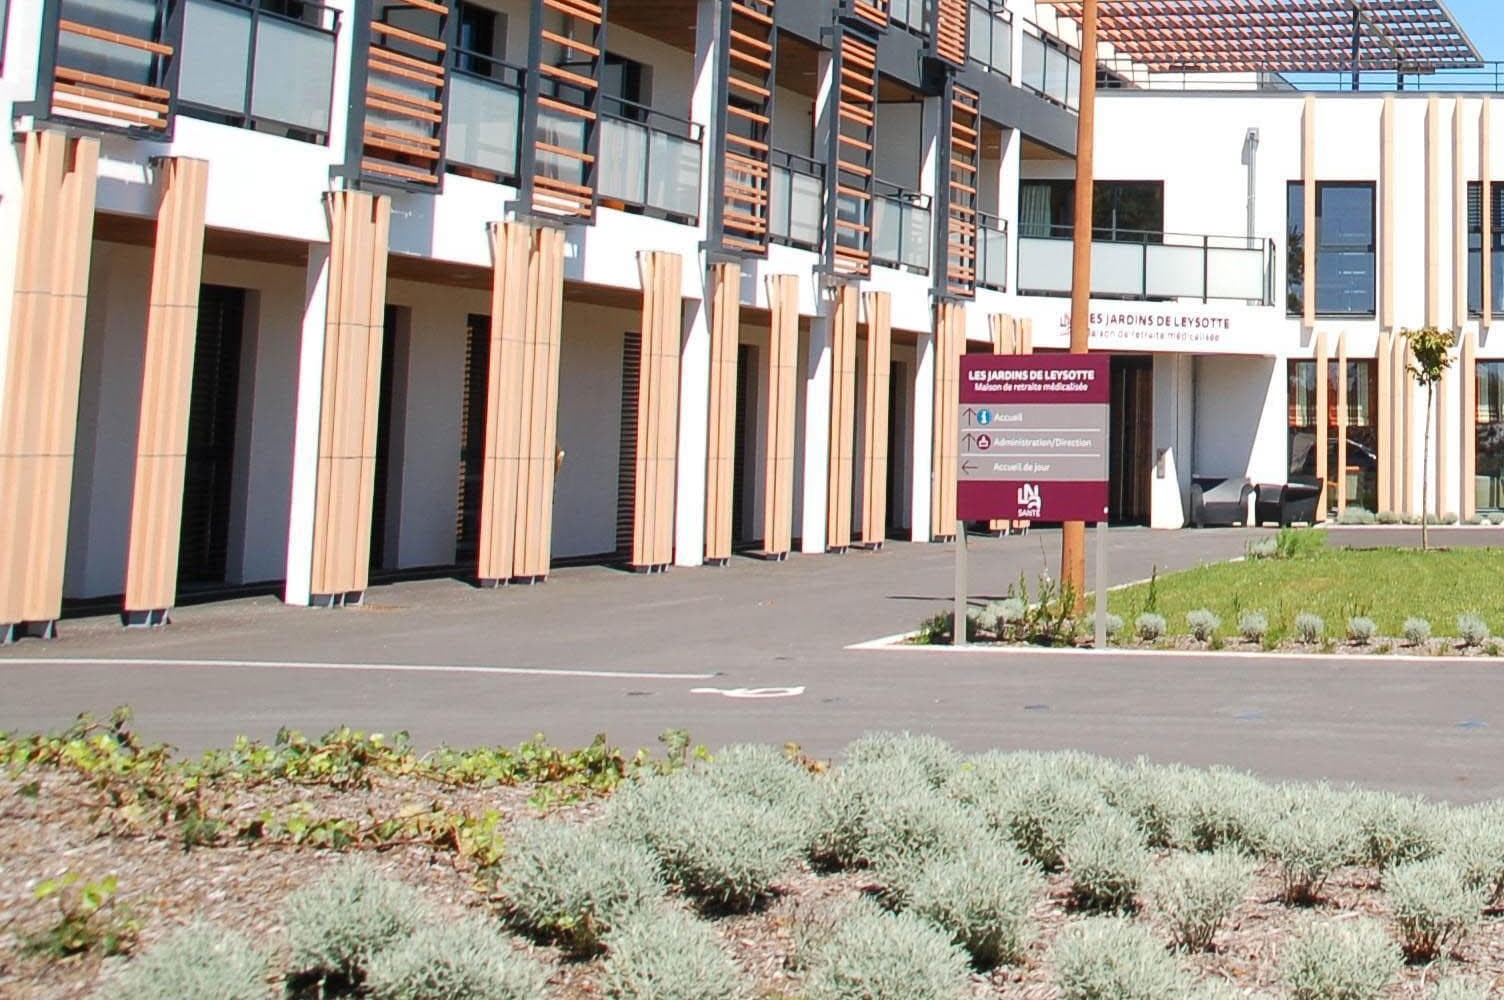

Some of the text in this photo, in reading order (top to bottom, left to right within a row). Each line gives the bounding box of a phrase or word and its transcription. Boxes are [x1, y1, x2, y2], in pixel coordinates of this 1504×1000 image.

[1089, 313, 1230, 329] ES JARDINS DE LEYSOTTE
[1088, 329, 1116, 338] aison
[1118, 330, 1129, 338] de
[968, 370, 1095, 383] LES JARDINS DE LEYSOTTE
[974, 381, 1089, 391] Maison de retraite médicalisée
[994, 413, 1023, 422] Accueil
[993, 438, 1092, 449] Administration/Direction
[993, 462, 1051, 473] Accueil de jour
